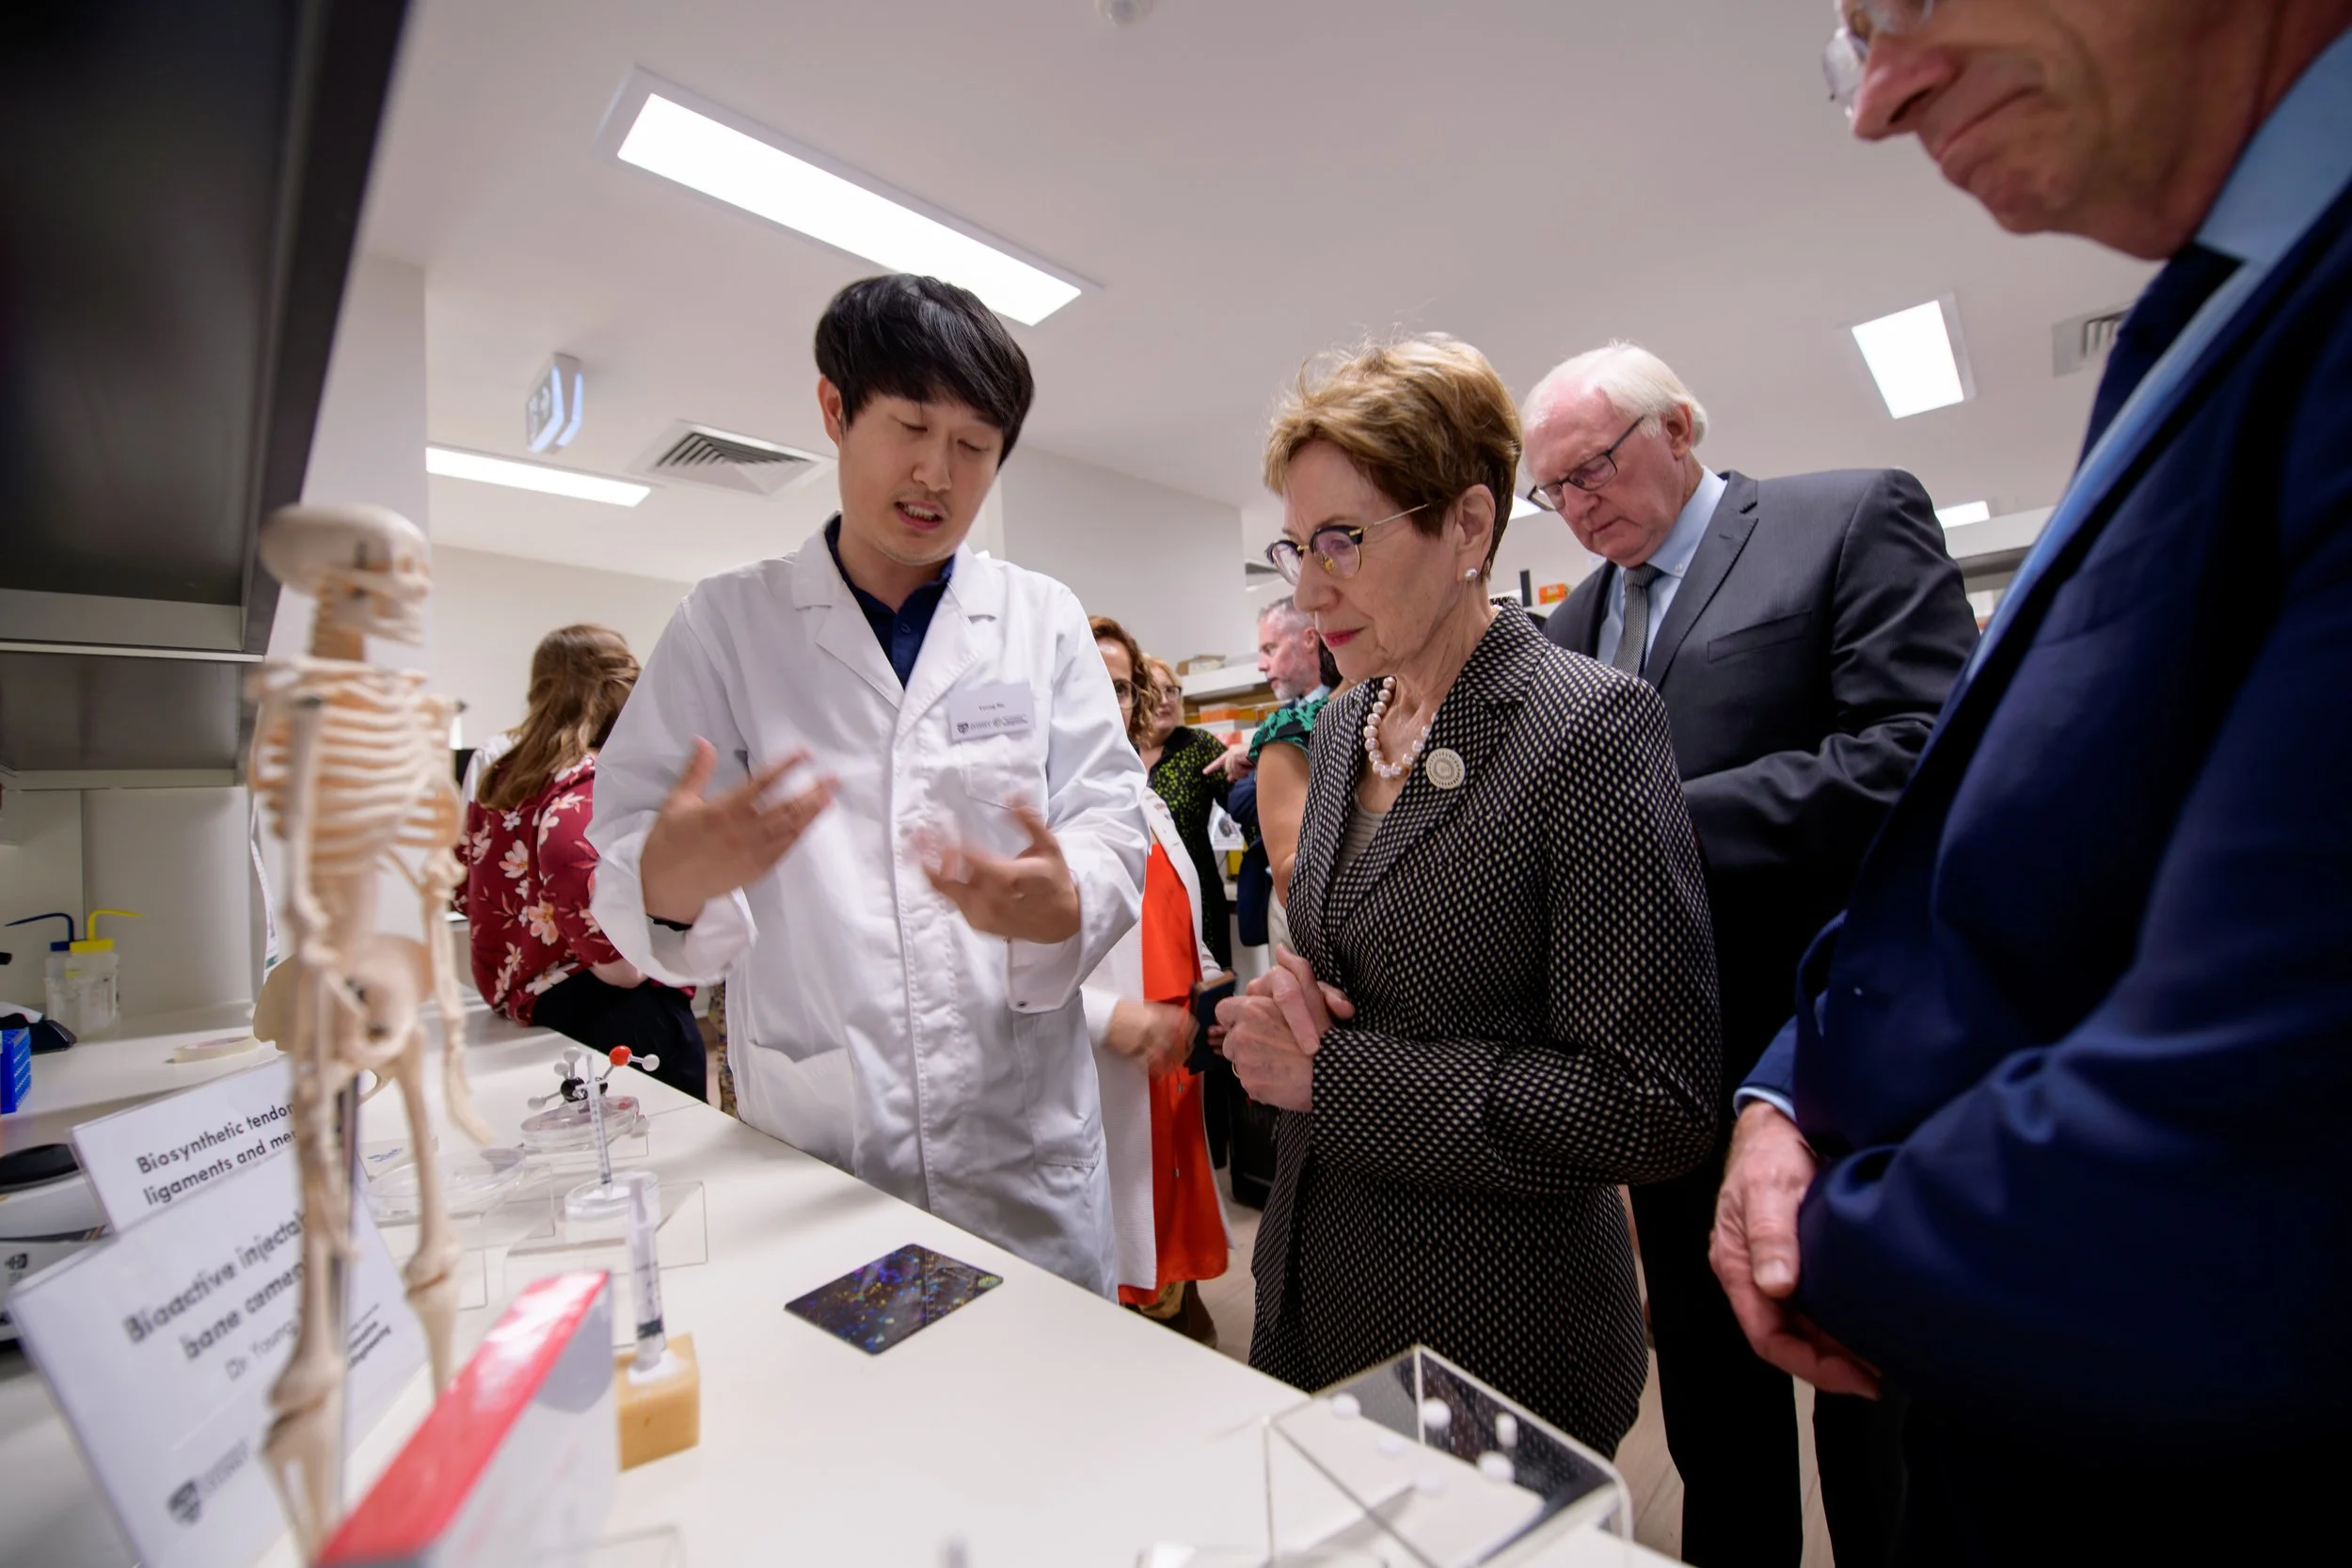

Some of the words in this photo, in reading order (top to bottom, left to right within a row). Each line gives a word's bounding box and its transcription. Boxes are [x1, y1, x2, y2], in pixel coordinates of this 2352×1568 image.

[135, 1120, 245, 1175] Biosynthetic
[142, 1158, 233, 1206] ligaments
[236, 1138, 267, 1164] and
[121, 1261, 237, 1346] Bioactive
